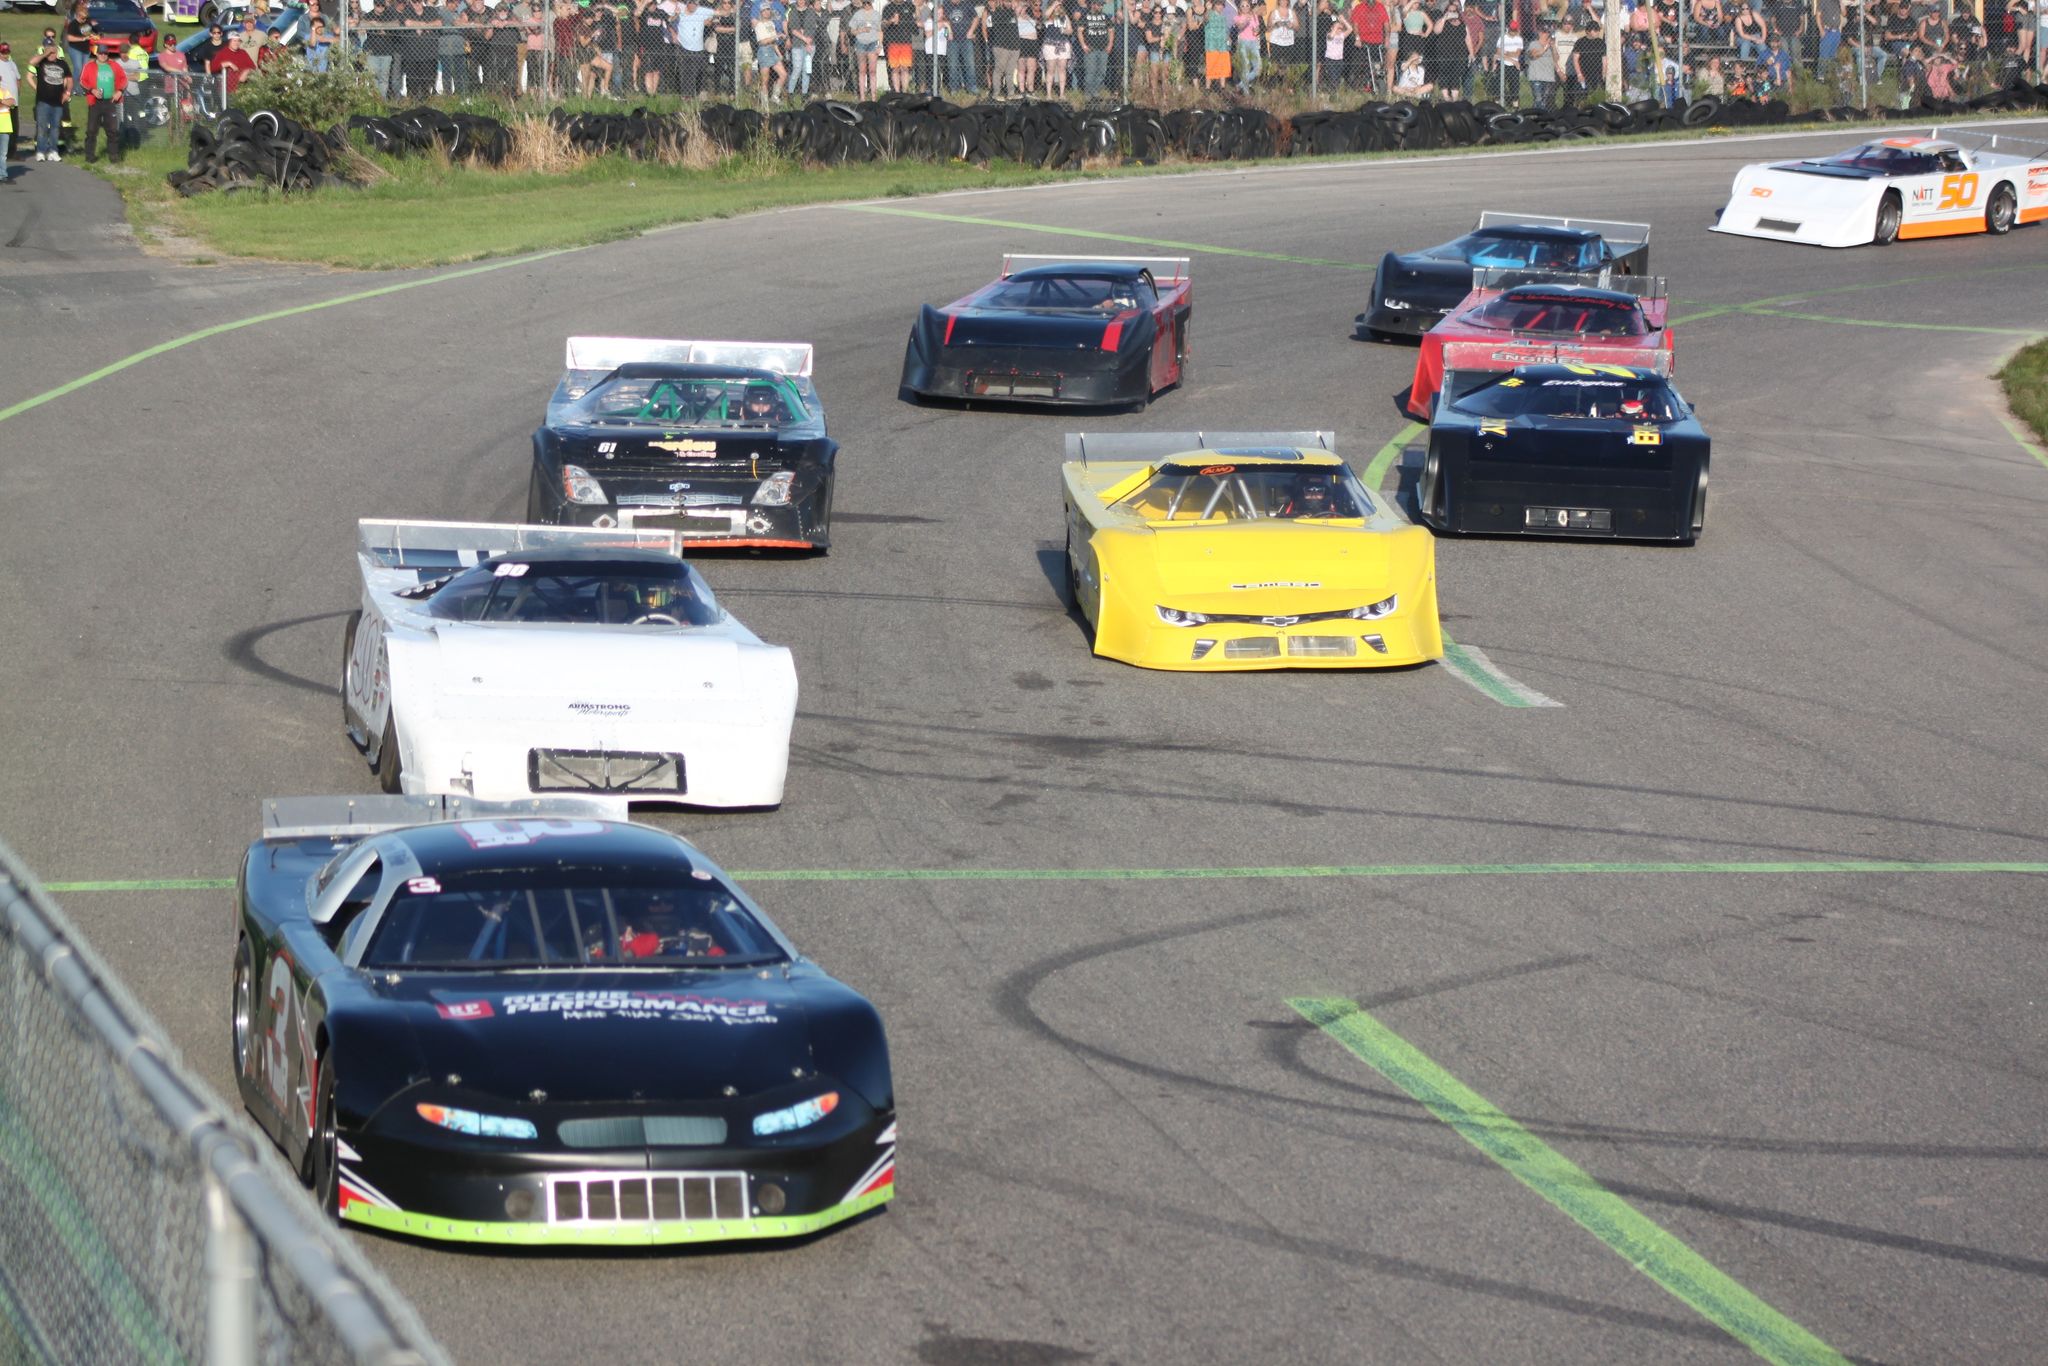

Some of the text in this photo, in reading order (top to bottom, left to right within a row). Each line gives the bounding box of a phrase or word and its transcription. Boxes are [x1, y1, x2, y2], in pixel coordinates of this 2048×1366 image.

[1751, 187, 1774, 198] 50
[1912, 185, 1934, 201] NATT
[1936, 173, 1979, 210] 50
[1491, 352, 1585, 365] ENGINES
[597, 442, 617, 453] 61
[493, 562, 530, 577] 90
[503, 990, 629, 1006] RITCHIE
[506, 999, 767, 1017] PERFORMANCE
